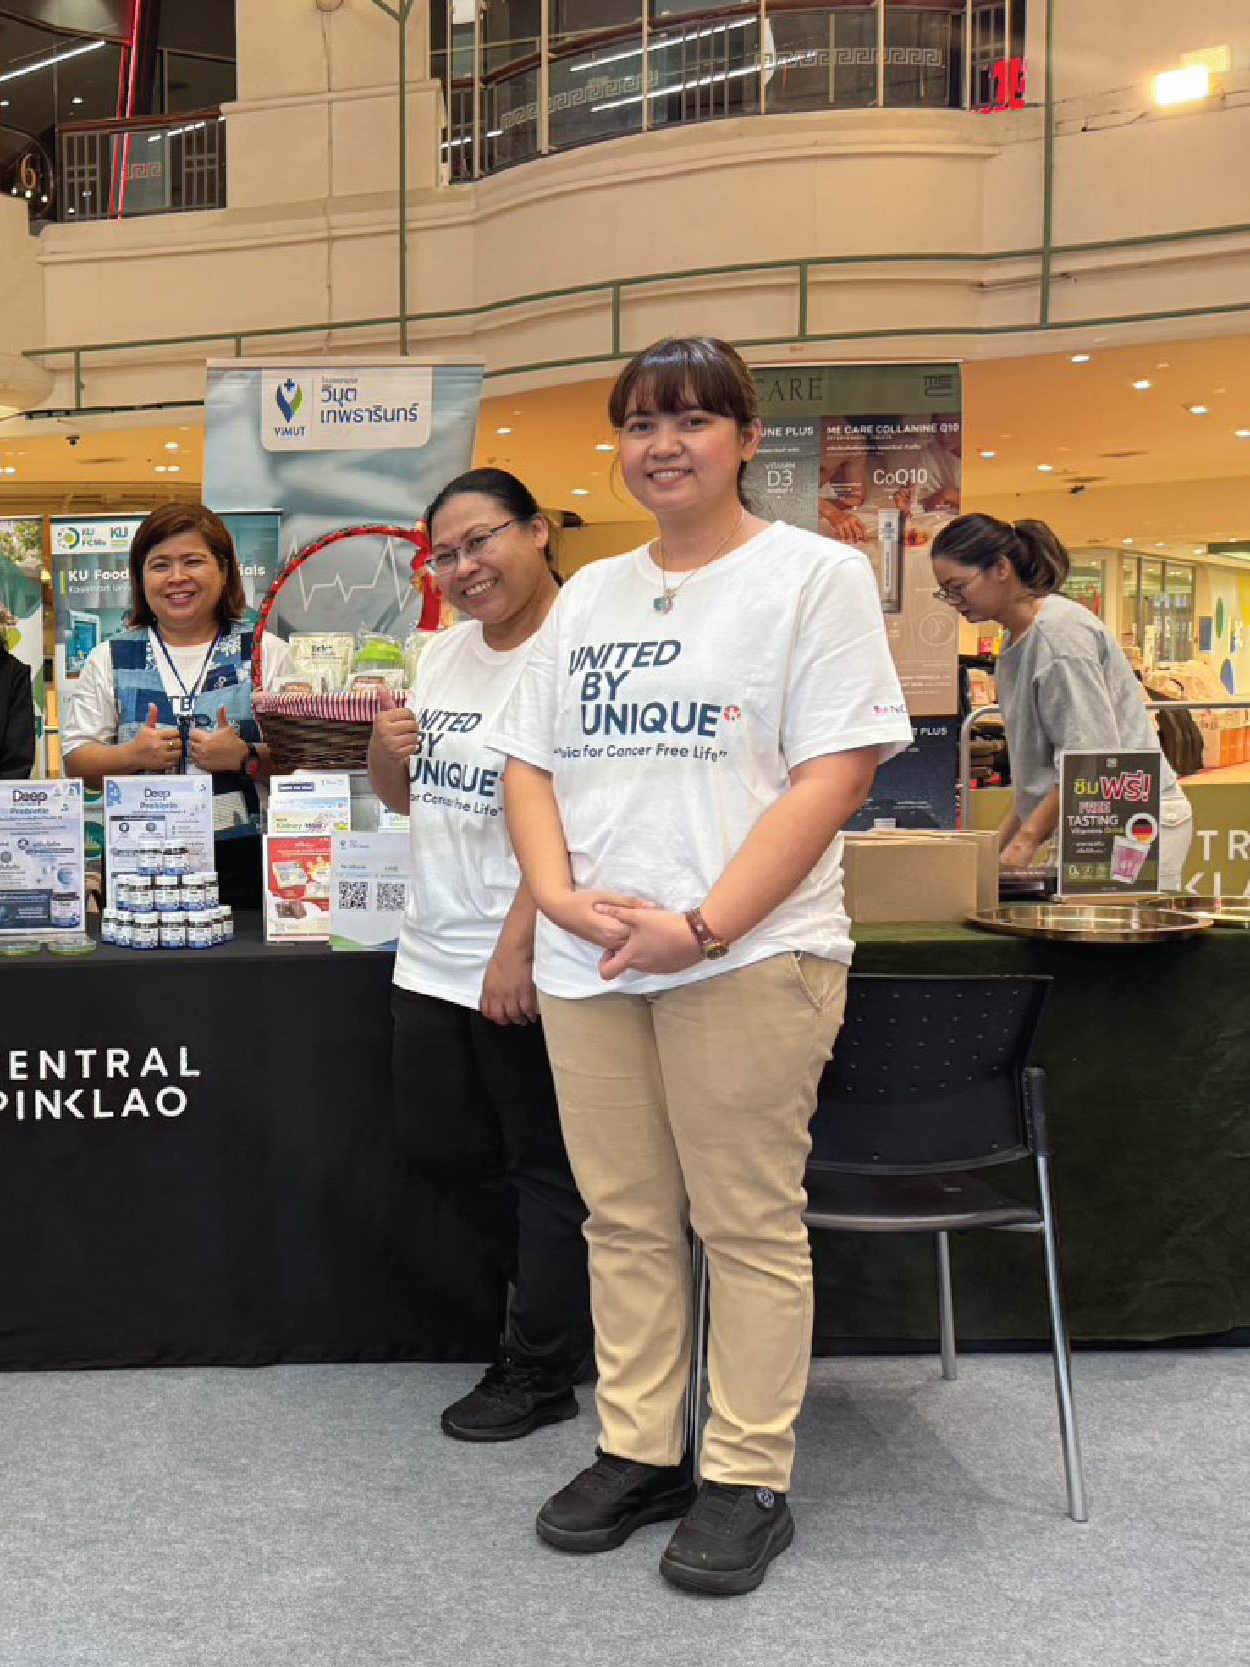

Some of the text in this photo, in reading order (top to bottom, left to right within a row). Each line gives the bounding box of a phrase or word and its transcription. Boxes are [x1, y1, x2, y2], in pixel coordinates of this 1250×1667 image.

[785, 426, 814, 437] PLUS
[767, 470, 792, 487] D3
[873, 468, 928, 485] CoQ10
[68, 570, 88, 582] KU
[94, 567, 131, 581] Food
[568, 640, 682, 677] UNITED
[581, 670, 631, 702] BY
[419, 708, 483, 733] NITED
[581, 701, 722, 737] UNIQUE
[920, 727, 948, 736] PLUS
[582, 744, 603, 758] for
[606, 744, 652, 758] Cancer
[655, 742, 689, 757] Free
[12, 789, 47, 806] Deep
[144, 787, 171, 801] Deep
[1066, 814, 1119, 827] TASTING
